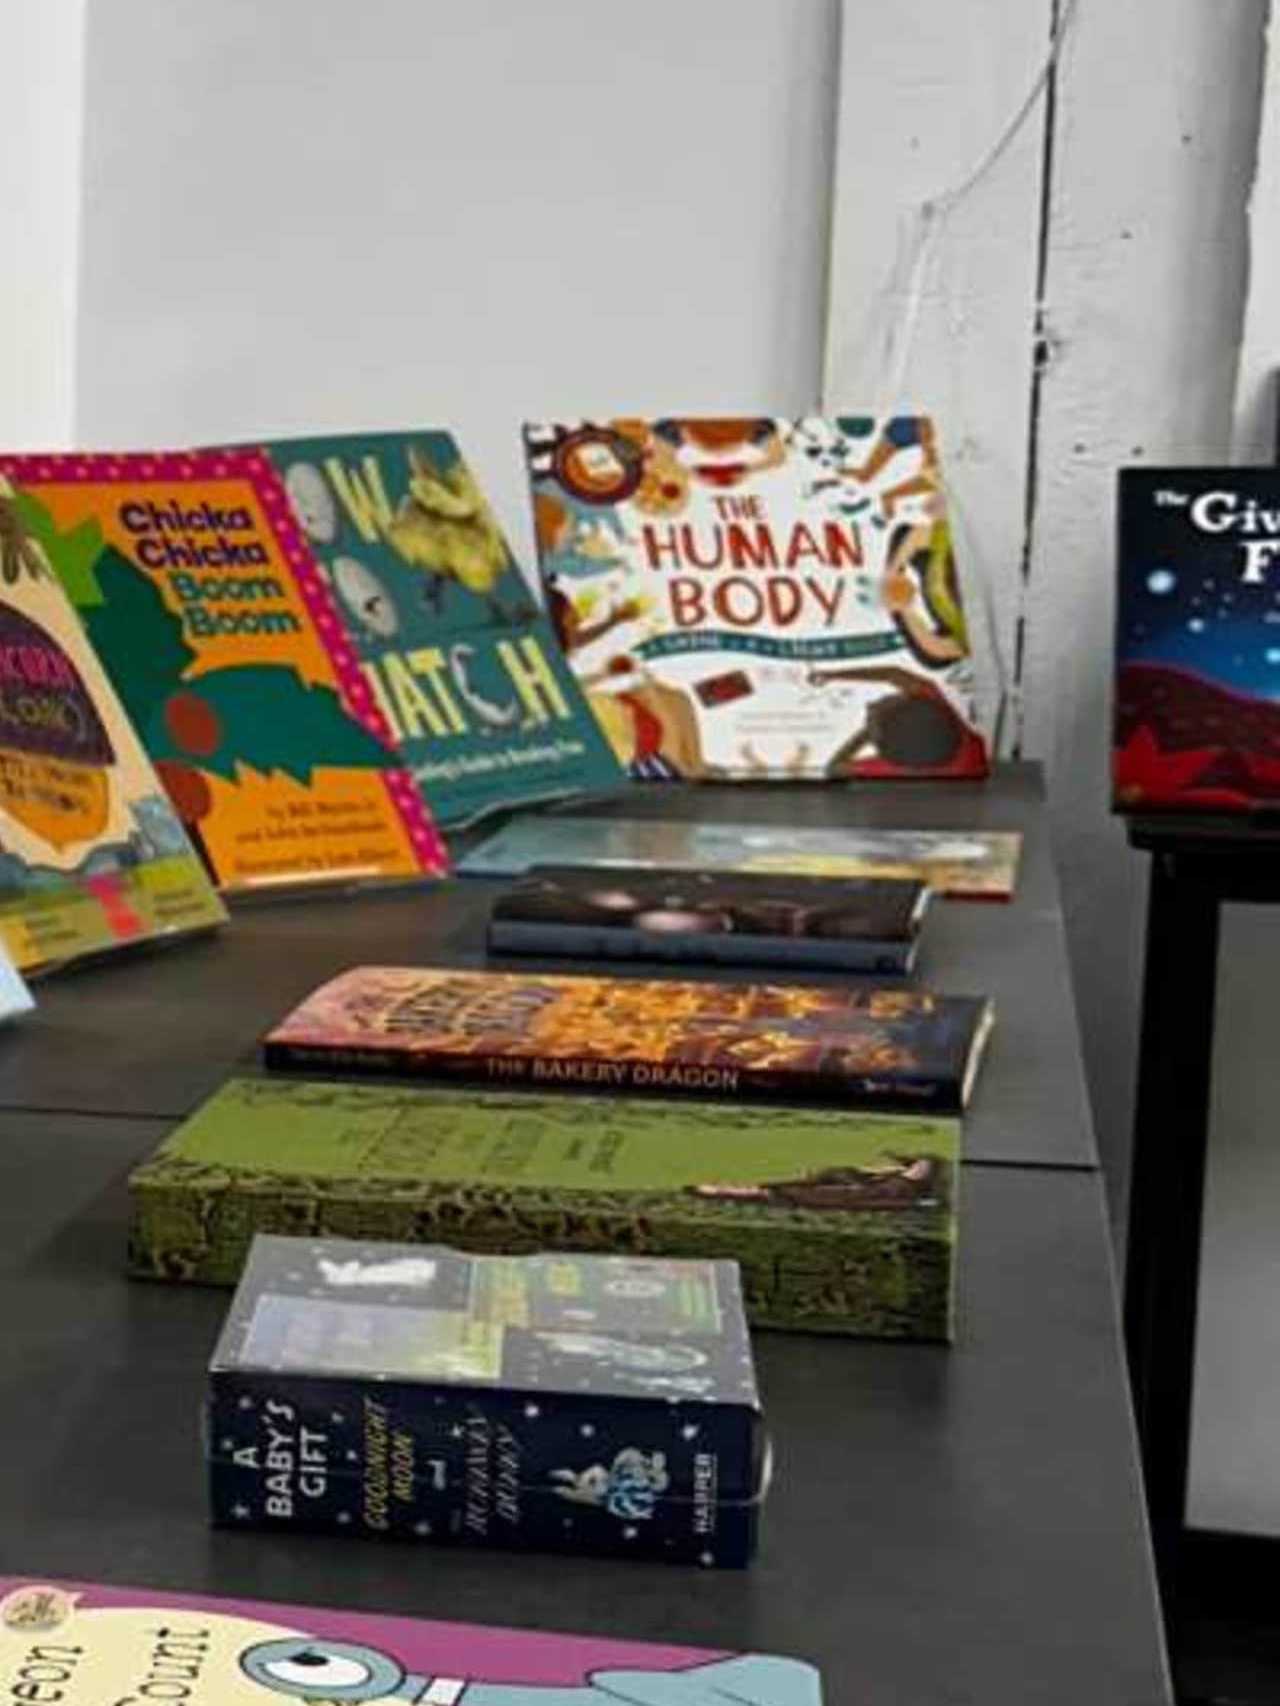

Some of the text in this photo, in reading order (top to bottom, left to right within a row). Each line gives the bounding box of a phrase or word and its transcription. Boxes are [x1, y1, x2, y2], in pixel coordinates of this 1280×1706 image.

[118, 499, 255, 536] Chicka
[716, 495, 767, 521] THE
[135, 533, 272, 569] Chicka
[641, 524, 864, 571] HUMAN
[168, 572, 286, 606] Boom
[669, 577, 846, 627] BODY
[184, 604, 302, 637] Boom
[488, 1057, 740, 1093] THE BAKERY DRAGON
[232, 1446, 260, 1470] A
[266, 1399, 297, 1518] BABY'S
[298, 1427, 330, 1498] GIFT
[362, 1398, 393, 1531] GOODNIGHT
[388, 1434, 416, 1502] MOON
